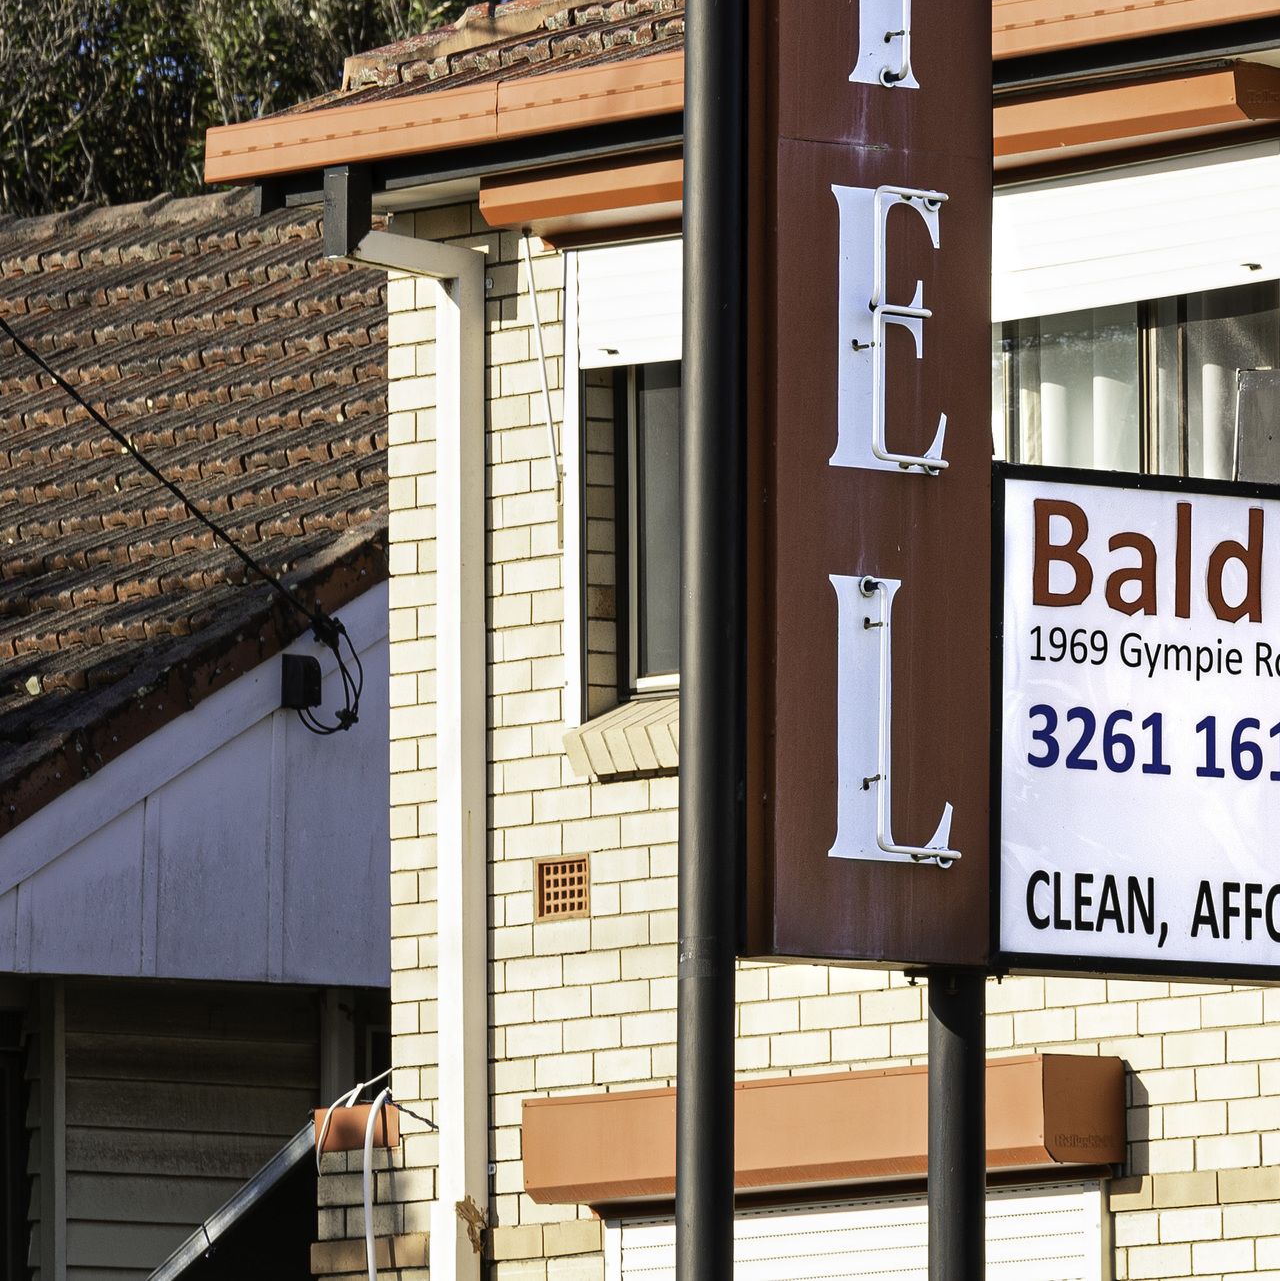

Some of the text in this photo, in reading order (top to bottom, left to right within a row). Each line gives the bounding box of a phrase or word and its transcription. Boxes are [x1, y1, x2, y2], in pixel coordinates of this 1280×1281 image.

[1033, 498, 1265, 624] Bald
[1030, 625, 1108, 666] 1969
[1119, 632, 1243, 682] Gympie
[1027, 703, 1172, 776] 3261
[1026, 869, 1168, 949] CLEAN,
